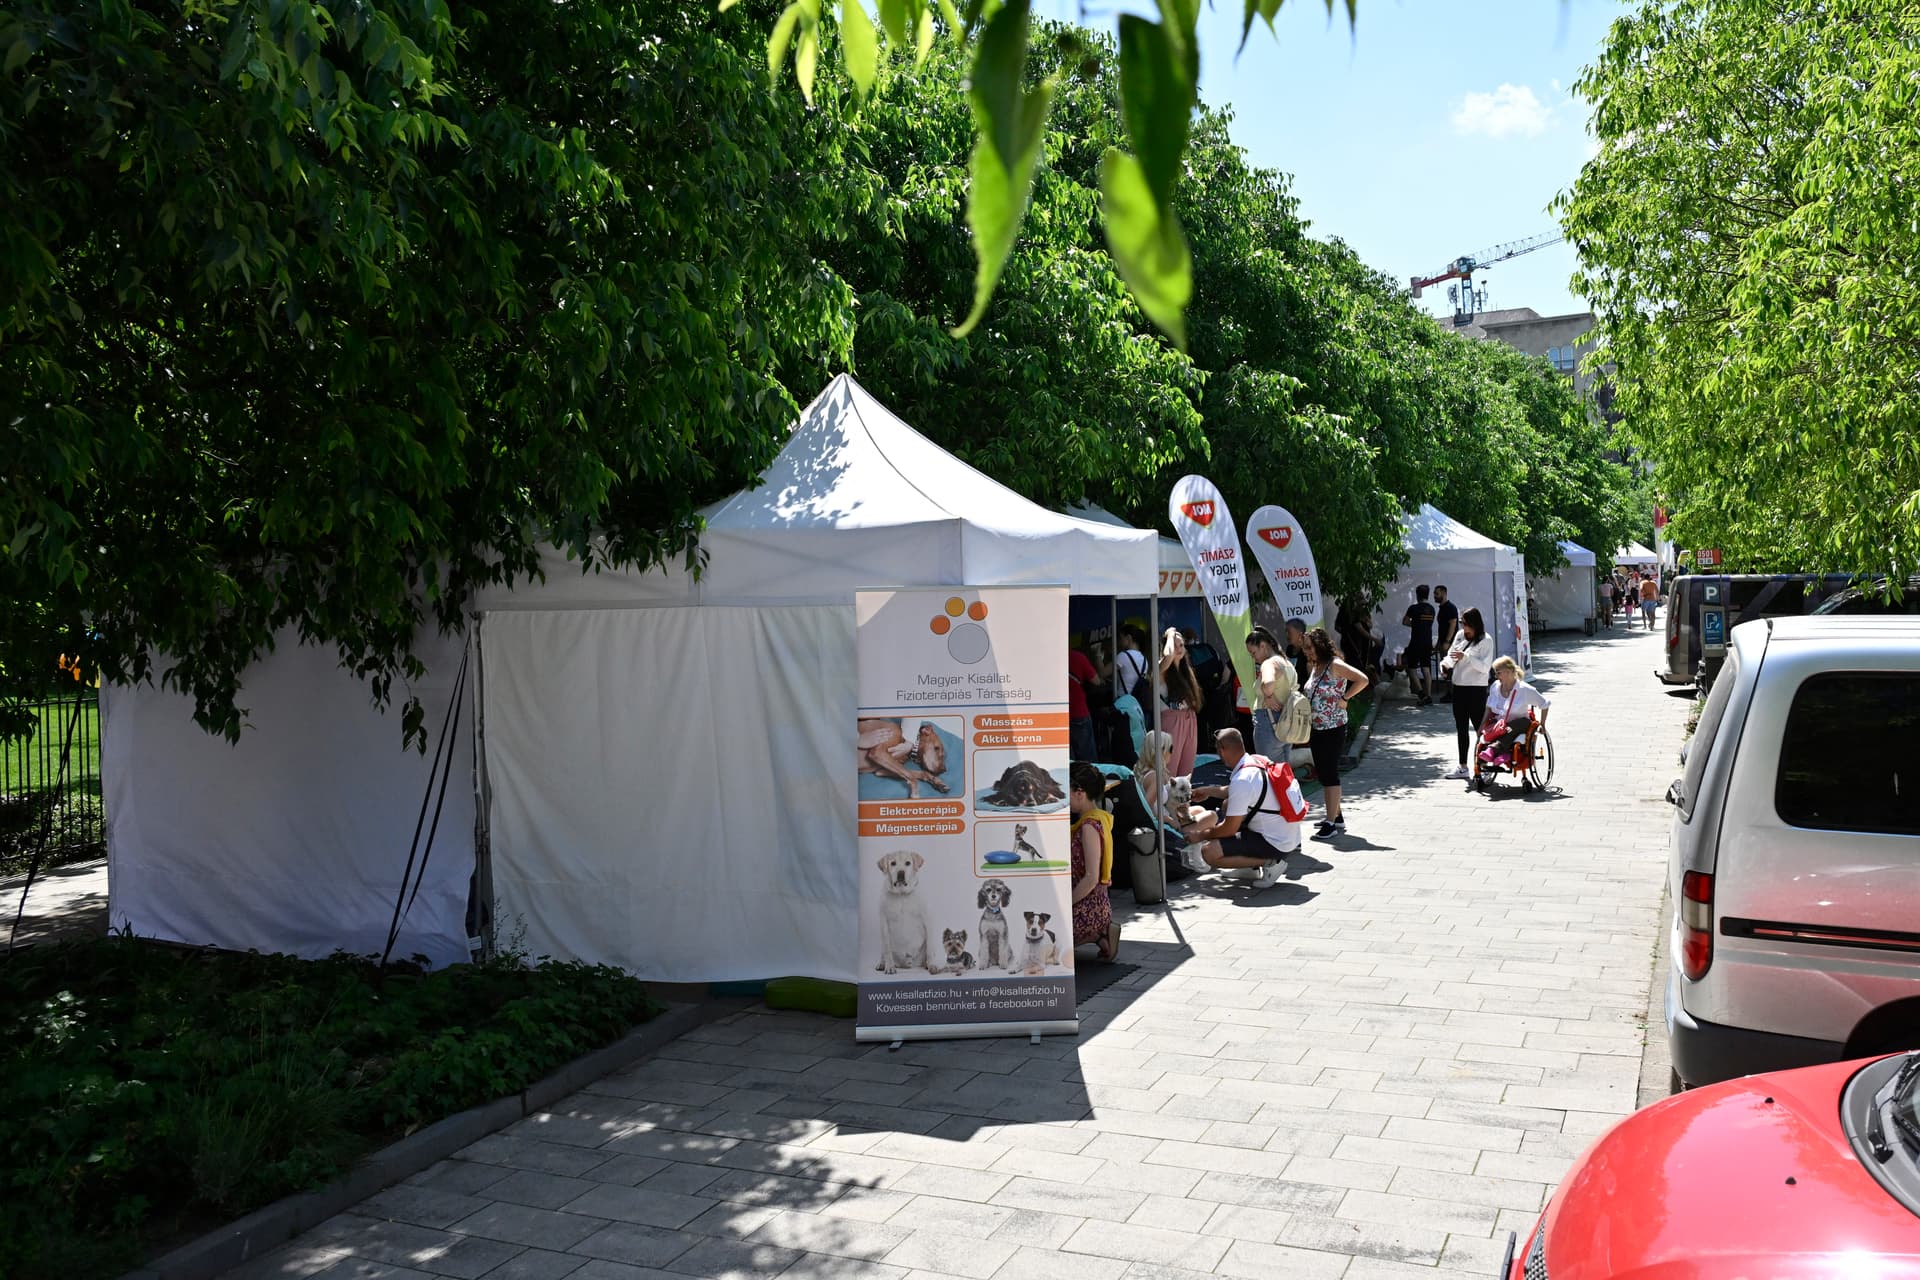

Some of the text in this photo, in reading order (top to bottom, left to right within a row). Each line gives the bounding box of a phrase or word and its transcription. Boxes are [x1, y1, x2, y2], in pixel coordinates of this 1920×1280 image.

[1697, 550, 1713, 558] 0501
[1706, 587, 1717, 600] P
[917, 672, 1011, 688] Magyar Kisállat
[896, 687, 1032, 702] Fizioterápiás Társaság
[981, 717, 1034, 727] Masszázs
[1012, 734, 1042, 743] torna
[879, 805, 957, 816] Elektroterápia
[876, 822, 957, 834] Mágnesterápia
[868, 985, 1066, 1001] www.kisallatfizio.hu info@kisallatfizio.hu
[989, 998, 1044, 1009] facebookon
[1047, 997, 1058, 1008] is!
